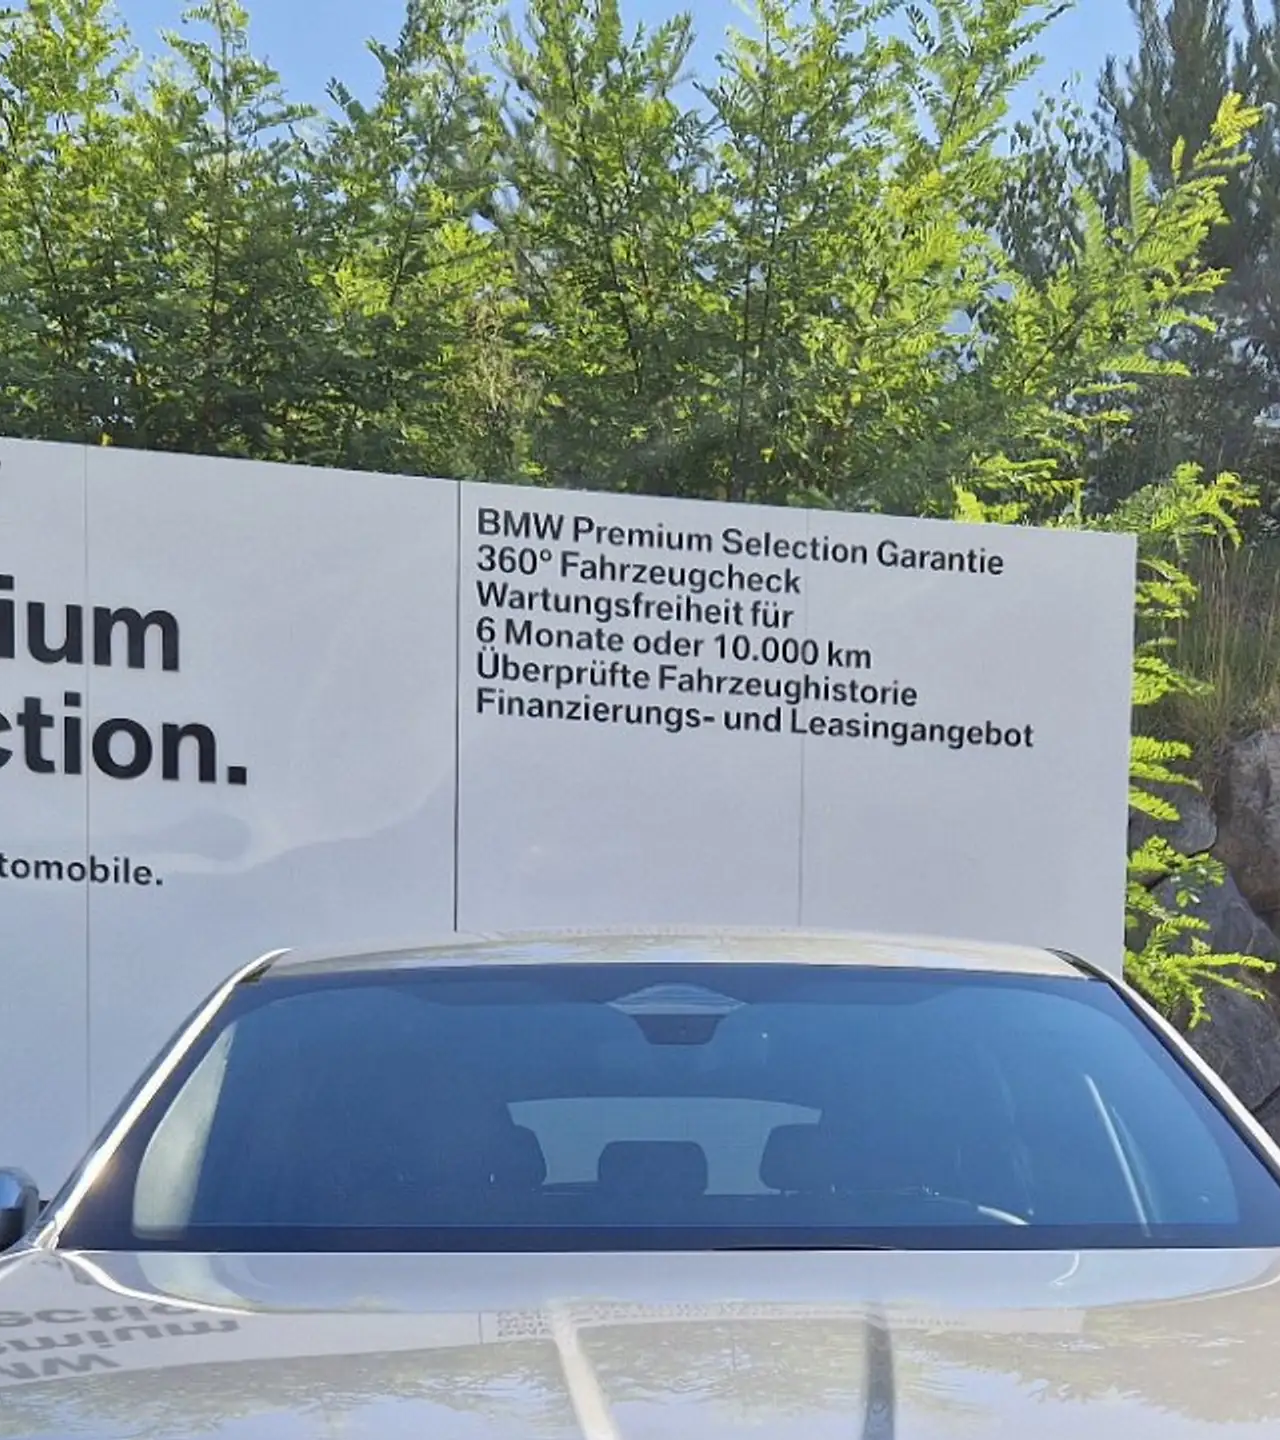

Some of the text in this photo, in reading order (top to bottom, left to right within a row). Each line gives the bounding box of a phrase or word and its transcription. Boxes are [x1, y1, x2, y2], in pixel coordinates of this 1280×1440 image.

[476, 544, 801, 594] 360° Fahrzeugcheck
[477, 508, 1004, 576] BMW Premium Selection Garantie
[476, 580, 794, 629] Wartungsfreiheit für
[476, 616, 872, 669] 6 Monate oder 10.000 km
[476, 647, 919, 707] Überprüfte Fahrzeughistorie
[477, 687, 1034, 750] Finanzierungs- und Leasingangebot
